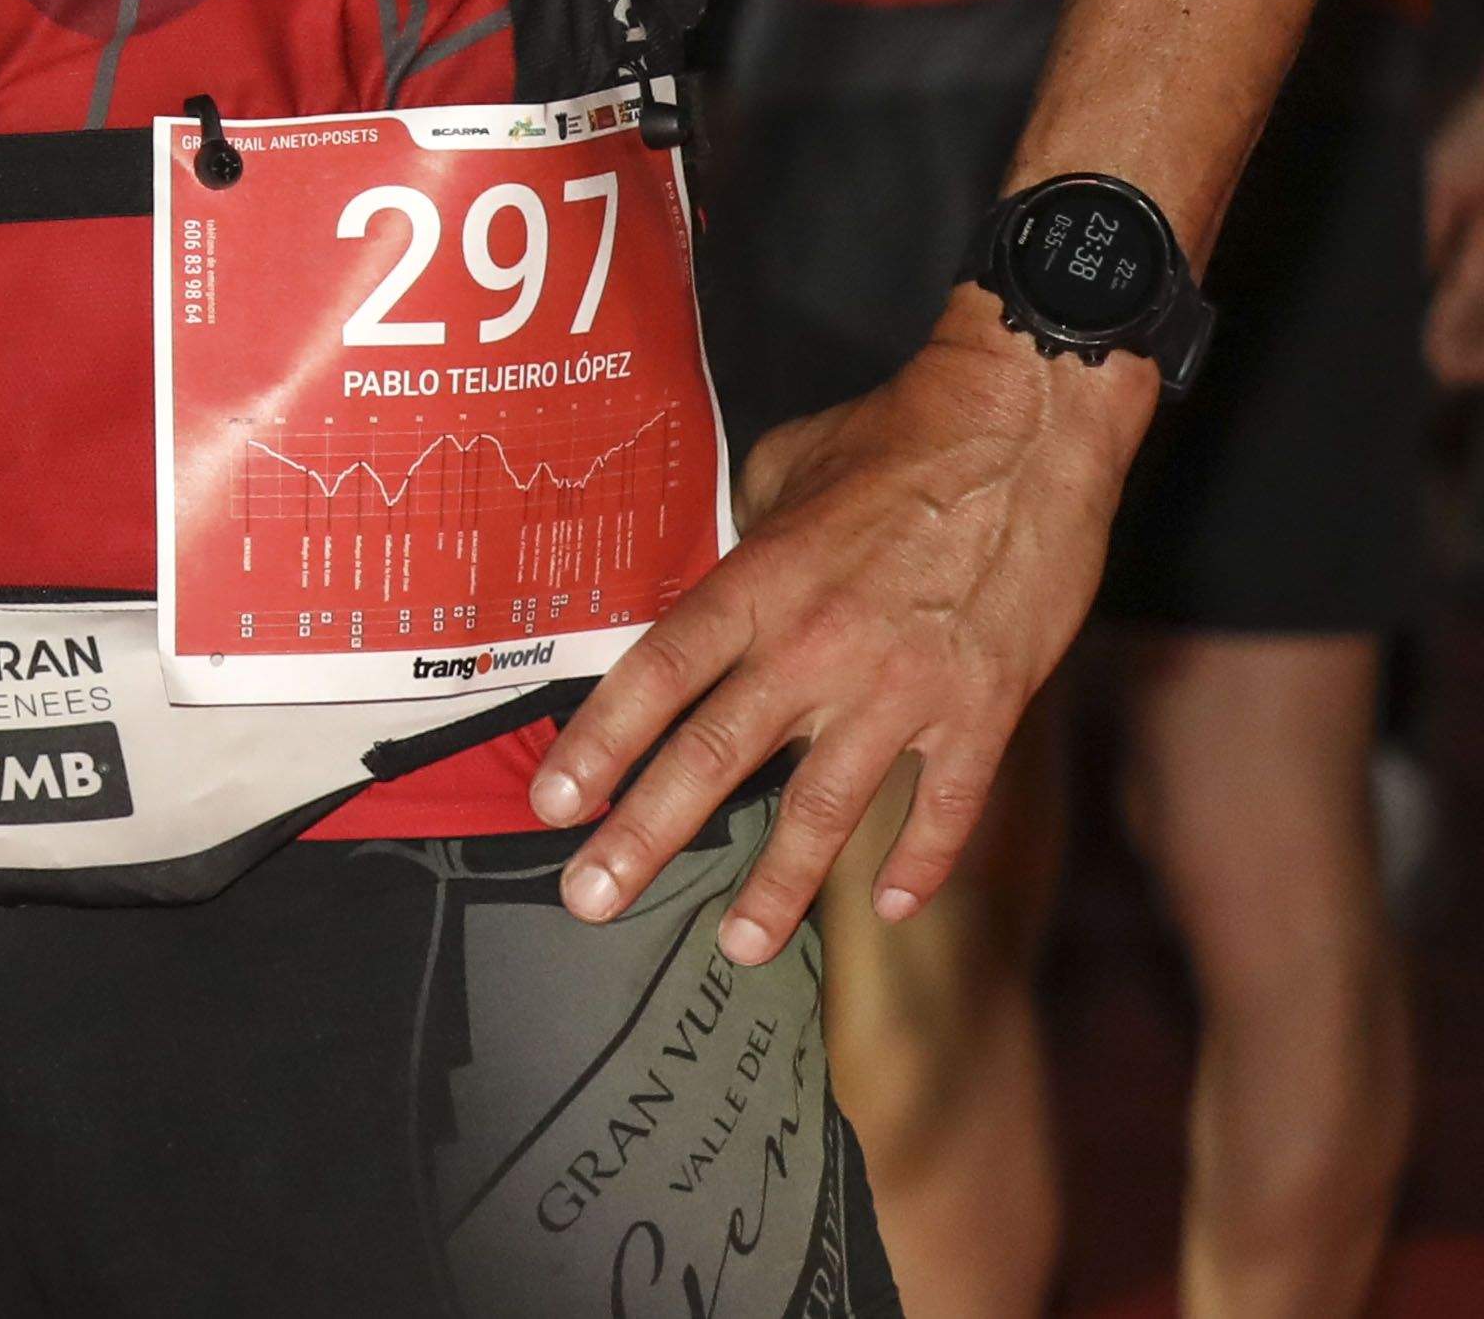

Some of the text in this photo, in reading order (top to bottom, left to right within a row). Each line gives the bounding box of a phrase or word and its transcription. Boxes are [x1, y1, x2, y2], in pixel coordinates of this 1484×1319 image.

[269, 128, 379, 151] ANETO-POSETS
[431, 126, 491, 138] SCARPA
[183, 219, 203, 324] 606 83 98 64
[334, 169, 619, 348] 297
[1067, 211, 1120, 282] 23:38
[342, 350, 633, 398] PABLO TEIJEIRO LÓPEZ
[668, 1017, 779, 1195] VALLE DEL
[535, 1068, 677, 1234] GRAN
